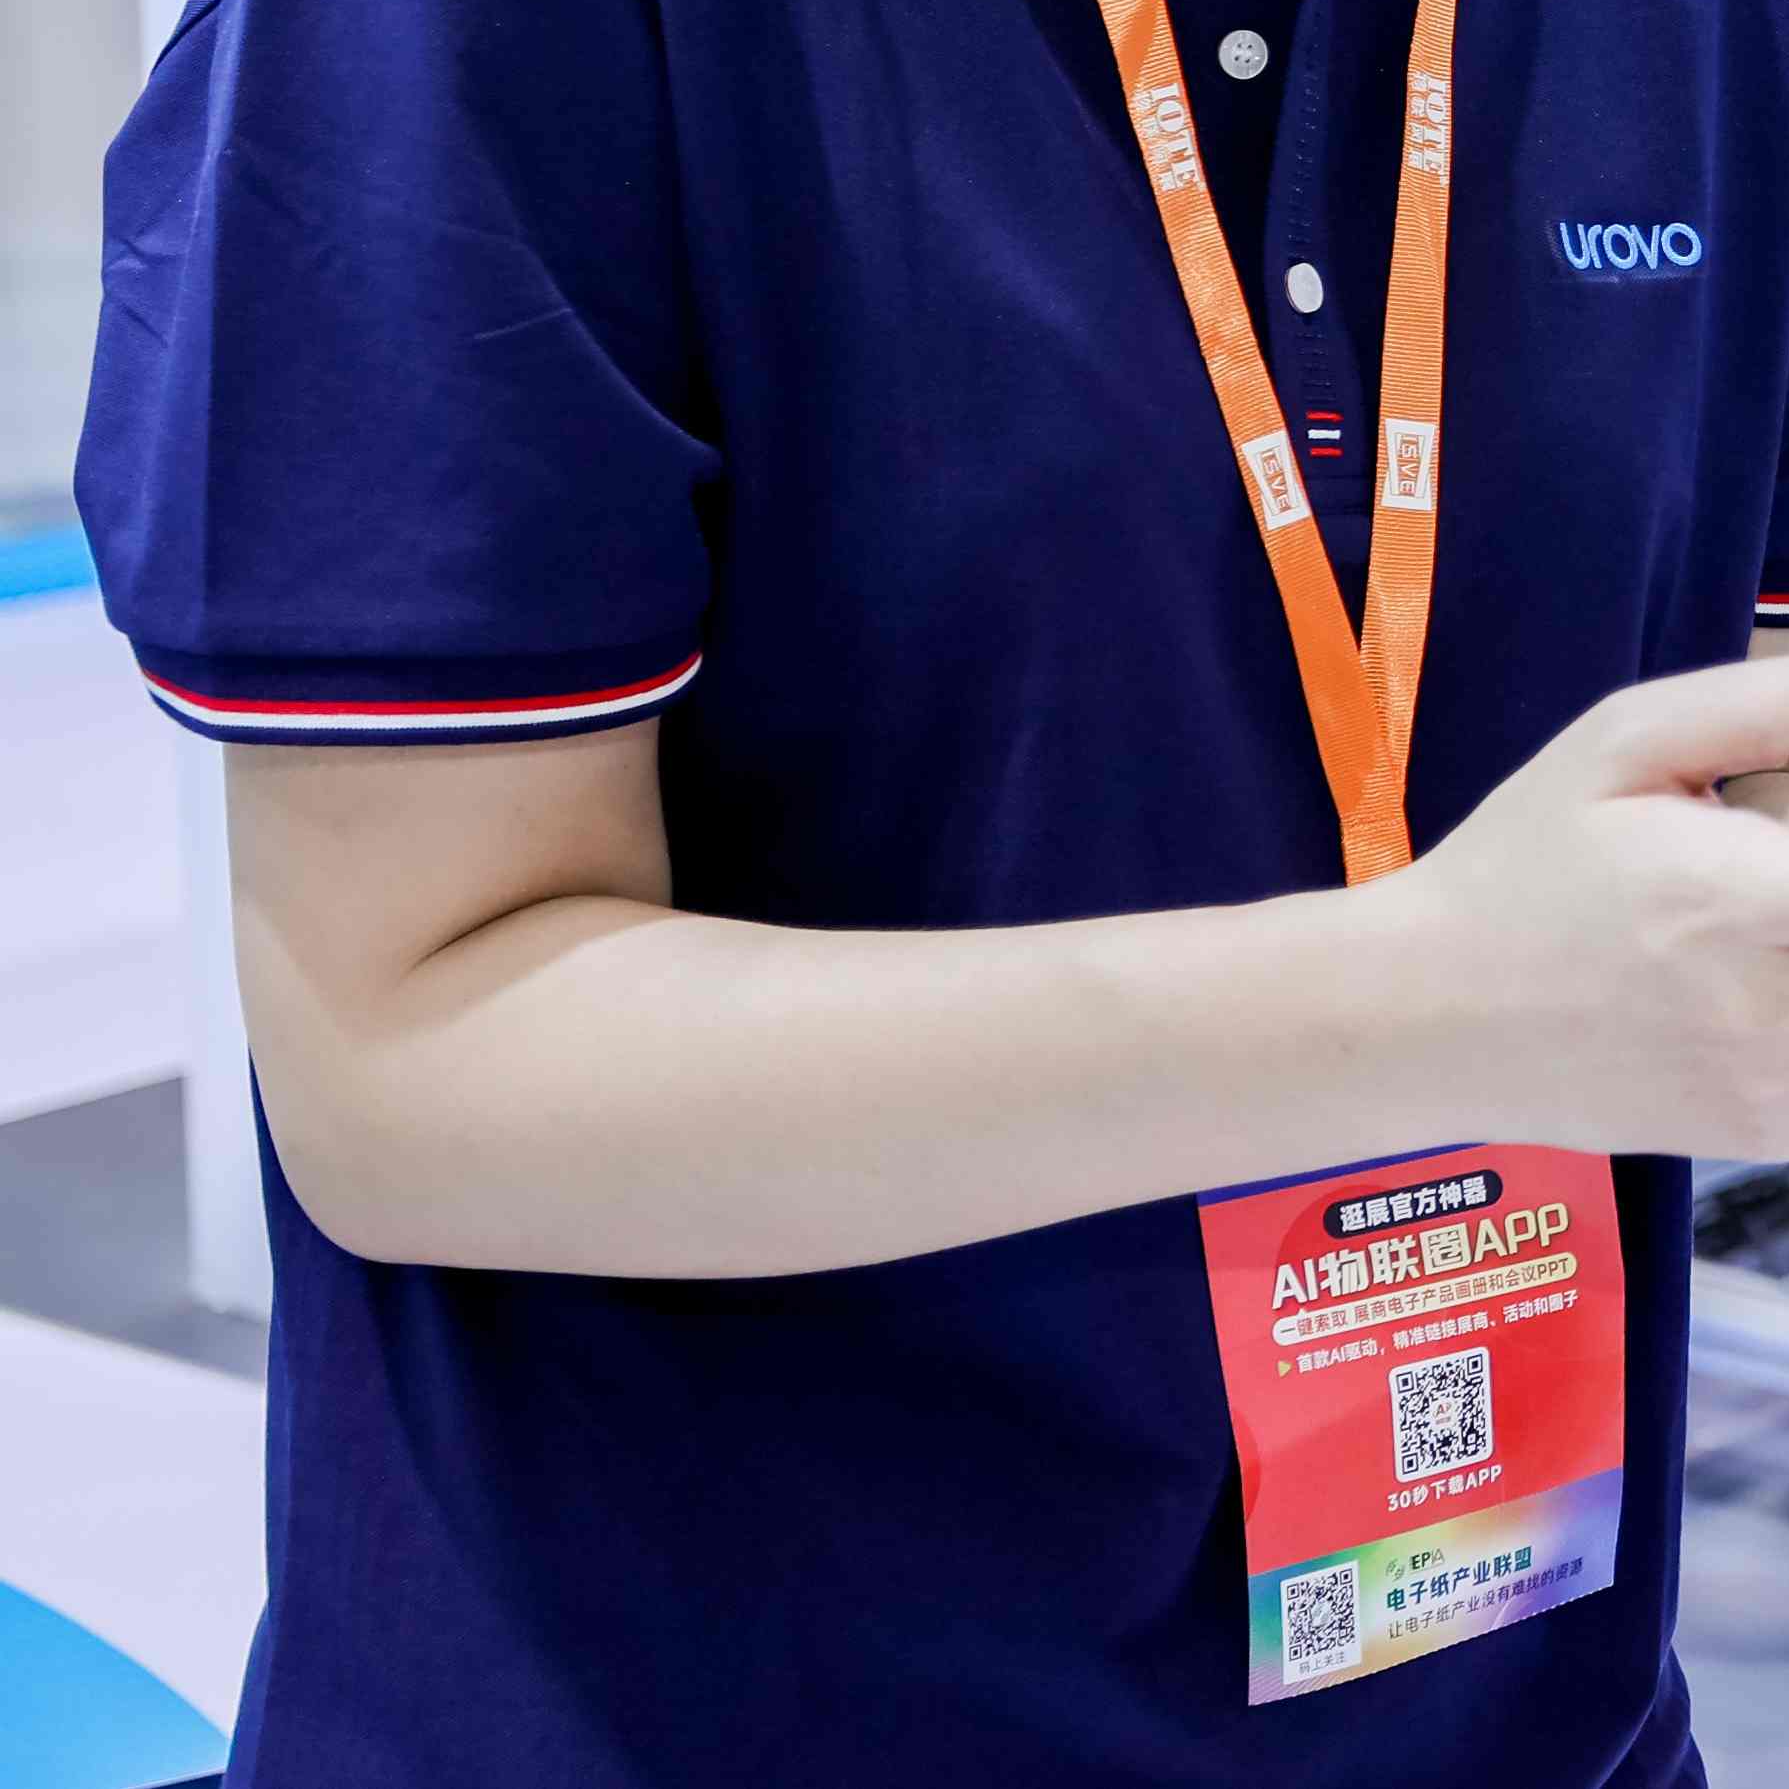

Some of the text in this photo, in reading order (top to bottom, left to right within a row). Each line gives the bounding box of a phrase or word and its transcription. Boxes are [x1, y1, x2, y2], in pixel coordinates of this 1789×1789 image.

[1560, 222, 1702, 269] urovo
[1340, 1175, 1487, 1232] 逛展官方神器
[1271, 1202, 1569, 1310] AI物联圈APP
[1281, 1257, 1569, 1337] 一键索取 展商电子产品画册和会议PPT
[1387, 1465, 1503, 1512] 30秒下载APP
[1386, 1546, 1533, 1612] 电子纸产业联盟
